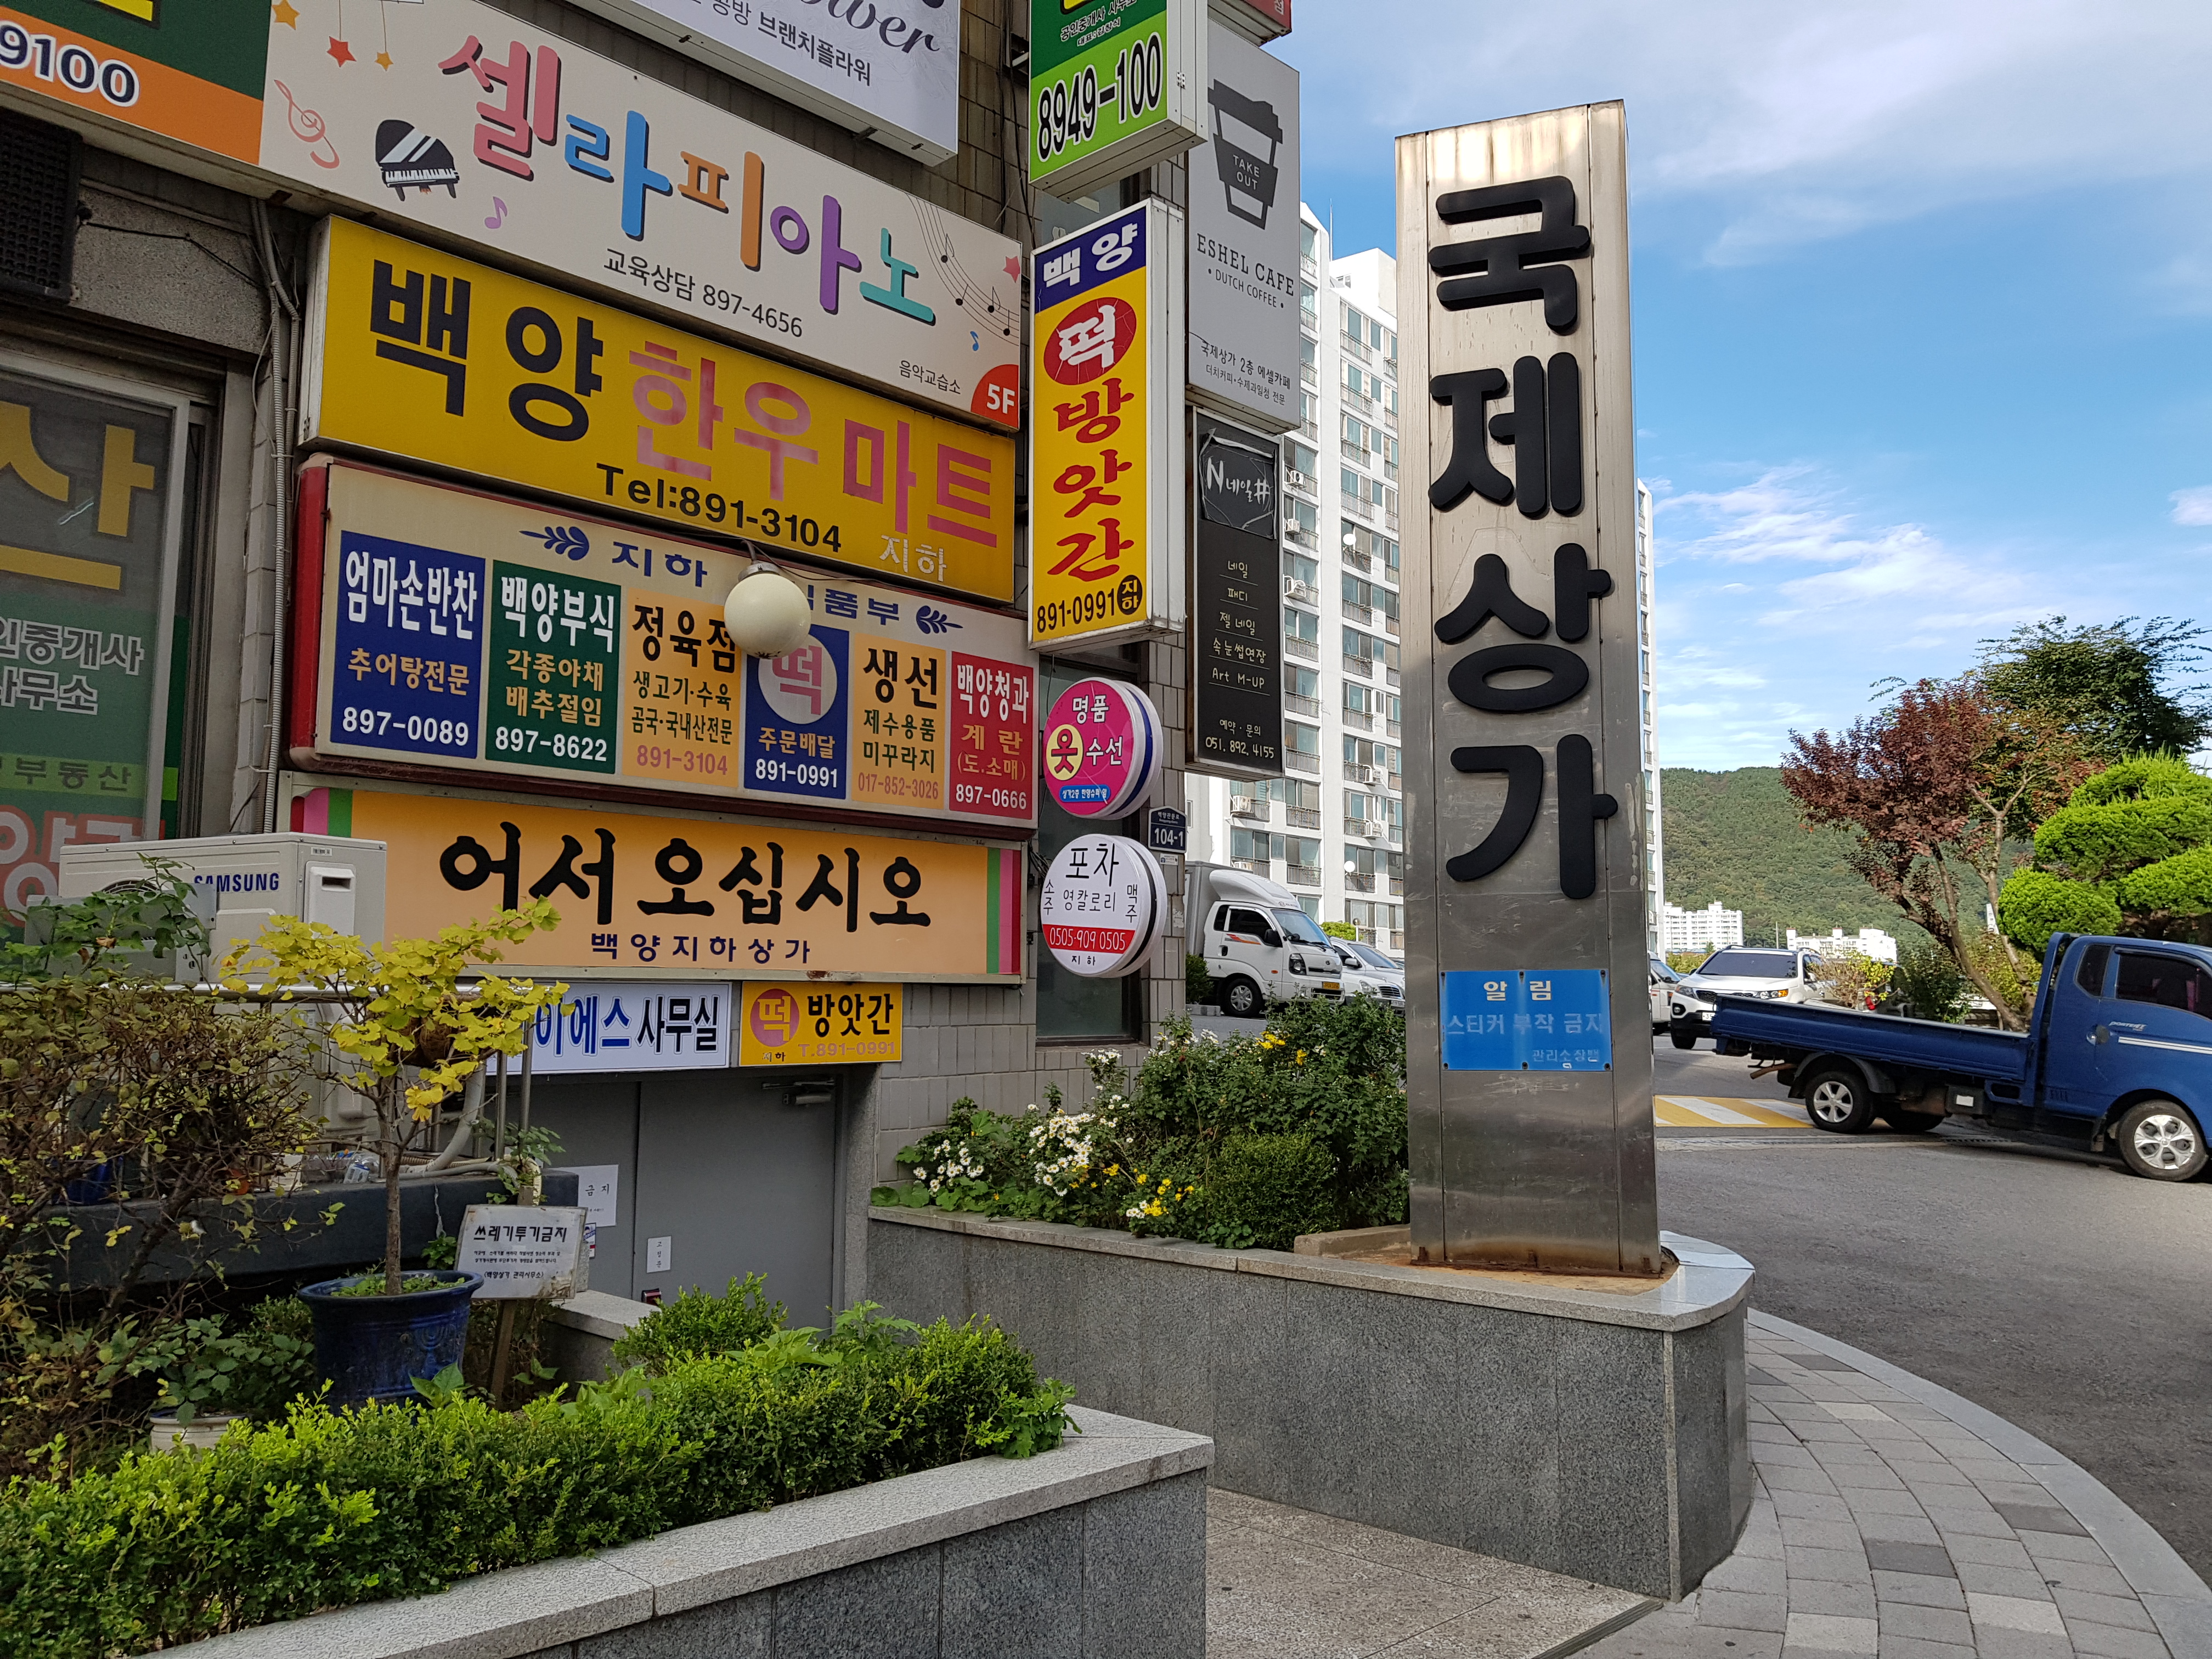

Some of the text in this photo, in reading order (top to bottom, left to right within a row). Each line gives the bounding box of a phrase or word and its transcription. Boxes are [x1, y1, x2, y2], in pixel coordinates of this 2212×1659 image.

[800, 0, 940, 53] wer
[1060, 5, 1105, 42] 공인중개사
[0, 24, 139, 107] 9100
[758, 11, 871, 86] 브랜치플라워
[1036, 32, 1163, 162] 8949-100
[1233, 154, 1261, 178] TAKE
[1236, 171, 1259, 190] OUT
[1043, 223, 1138, 287] 백양
[1197, 233, 1294, 296] ESHEL CAFE
[603, 248, 802, 337] 교육상담 897-4656
[1215, 272, 1277, 308] DUTCH COFFEE
[899, 360, 961, 394] 음악교습소
[1201, 341, 1290, 390] 국제상가 2층 에셀카페
[987, 383, 1014, 414] 5F
[1273, 391, 1285, 405] 전문
[879, 534, 947, 583] 지하
[1228, 560, 1248, 579] 네일
[345, 551, 478, 640] 엄마손반찬
[612, 541, 900, 625] 지하 품부
[1121, 579, 1139, 609] 지하
[1228, 588, 1248, 602] 패디
[501, 576, 616, 653] 백양부식
[1037, 588, 1116, 633] 891-0991
[1220, 612, 1255, 636] 젤 네일
[631, 605, 736, 673] 정육점
[348, 648, 470, 696] 추어탕전문
[506, 649, 605, 692] 각종야채
[772, 645, 822, 715] 떡
[863, 648, 937, 709] 생선
[1212, 667, 1265, 689] Art M-UP
[506, 686, 602, 727] 배추절임
[957, 664, 1029, 724] 백양청과
[1073, 695, 1109, 724] 명품
[342, 707, 469, 747] 897-0089
[758, 727, 835, 759] 주문배달
[863, 709, 935, 742] 제수용품
[1220, 719, 1261, 738] 예약 문의
[495, 726, 607, 761] 897-8622
[636, 744, 728, 775] 891-3104
[863, 741, 935, 774] 미꾸라지
[1086, 736, 1122, 765] 수선
[1252, 743, 1274, 759] 4155
[14, 758, 132, 792] 부동산
[755, 759, 837, 788] 891-0991
[858, 772, 939, 800] 017-852-3026
[955, 783, 1026, 810] 897-0666
[1154, 828, 1183, 847] 104-1
[439, 821, 930, 933] 어서 오십시오
[1065, 843, 1119, 887] 포차
[1043, 879, 1054, 915] 소주
[1063, 889, 1115, 912] 영칼로리
[1125, 884, 1138, 923] 맥주
[1071, 955, 1096, 966] 지하
[757, 994, 894, 1041] 떡 방앗간
[1448, 1013, 1602, 1035] 스티커 부착 금지
[585, 1183, 610, 1197] 금지
[473, 1226, 567, 1242] 쓰레기투기금지
